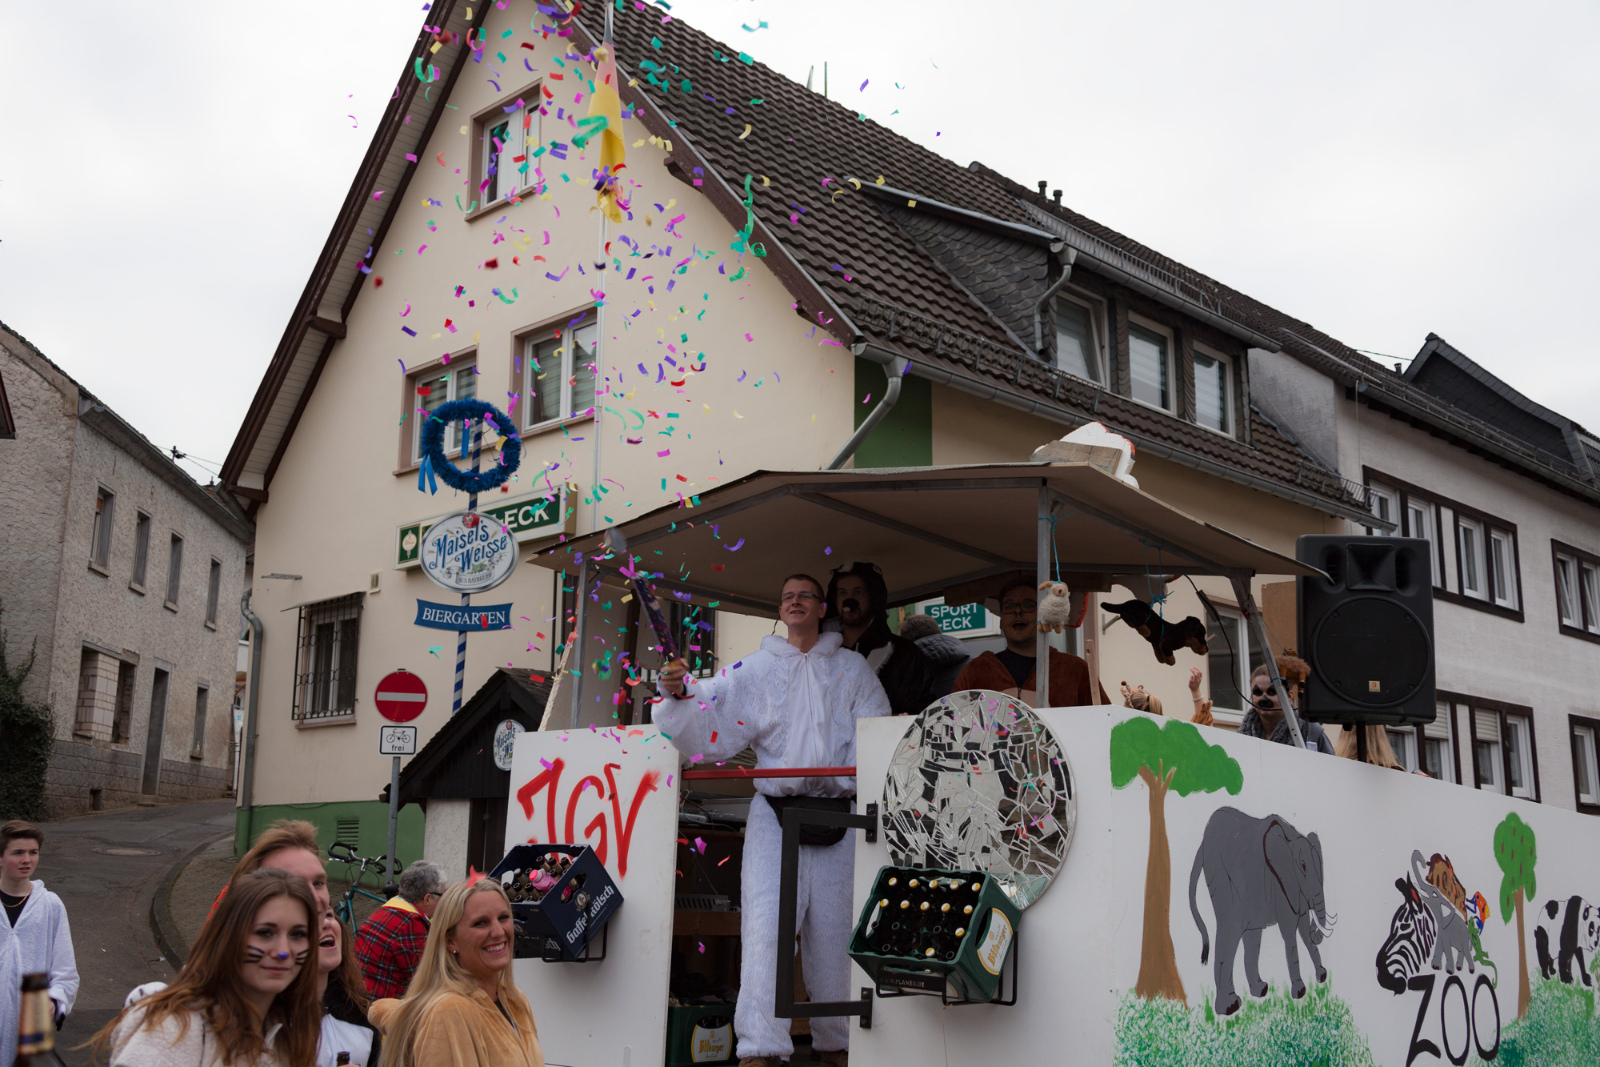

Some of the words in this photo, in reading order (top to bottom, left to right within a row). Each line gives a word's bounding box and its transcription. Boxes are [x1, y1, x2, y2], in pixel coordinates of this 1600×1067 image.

[428, 519, 489, 570] Maisel's
[454, 534, 508, 573] Weisse
[931, 603, 977, 619] SPORT
[391, 744, 405, 752] frei
[987, 924, 1008, 967] Bitburger
[1406, 973, 1501, 1067] ZOO
[699, 1039, 725, 1055] Bitburger
